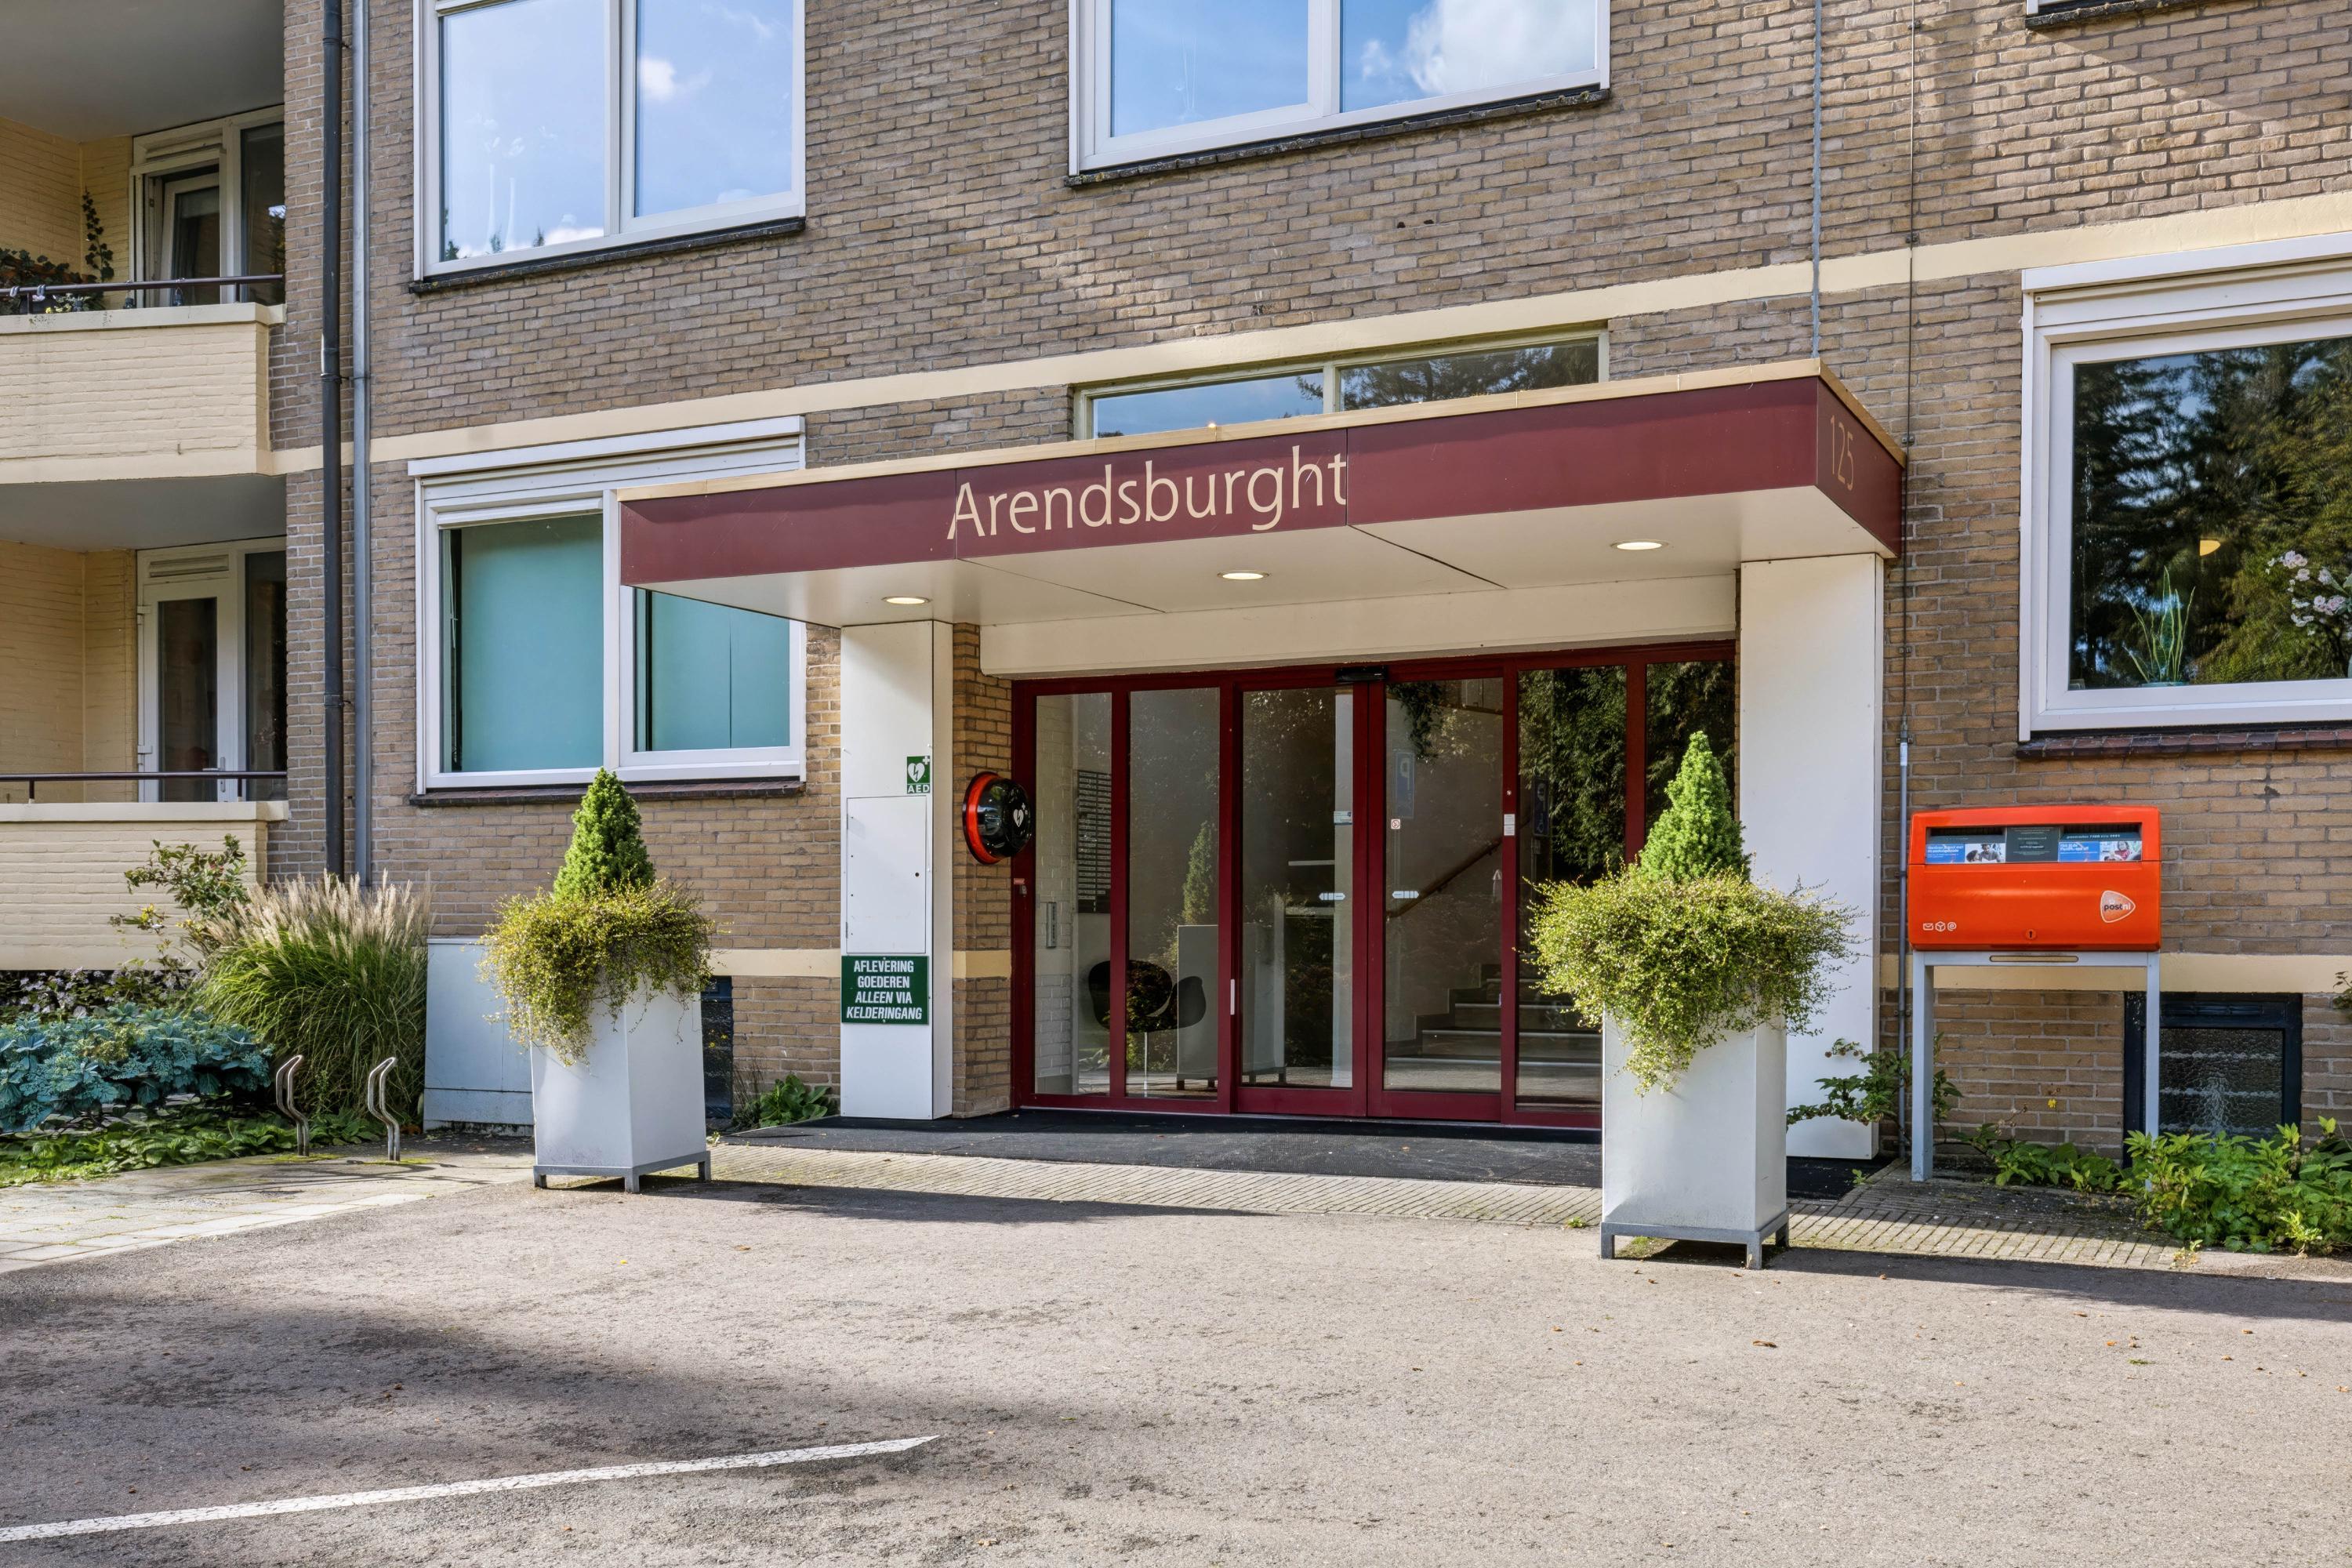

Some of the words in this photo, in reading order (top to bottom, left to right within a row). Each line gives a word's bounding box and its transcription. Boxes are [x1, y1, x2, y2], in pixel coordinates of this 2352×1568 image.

[1830, 415, 1853, 491] 125
[946, 445, 1347, 540] Arendsburght
[907, 784, 930, 793] AED
[2103, 902, 2131, 912] postnl
[853, 960, 914, 973] AFLEVERING
[857, 975, 910, 989] GOEDEREN
[855, 991, 893, 1004] ALLEEN
[895, 991, 913, 1004] VIA
[846, 1006, 923, 1020] KELDERINGANG
